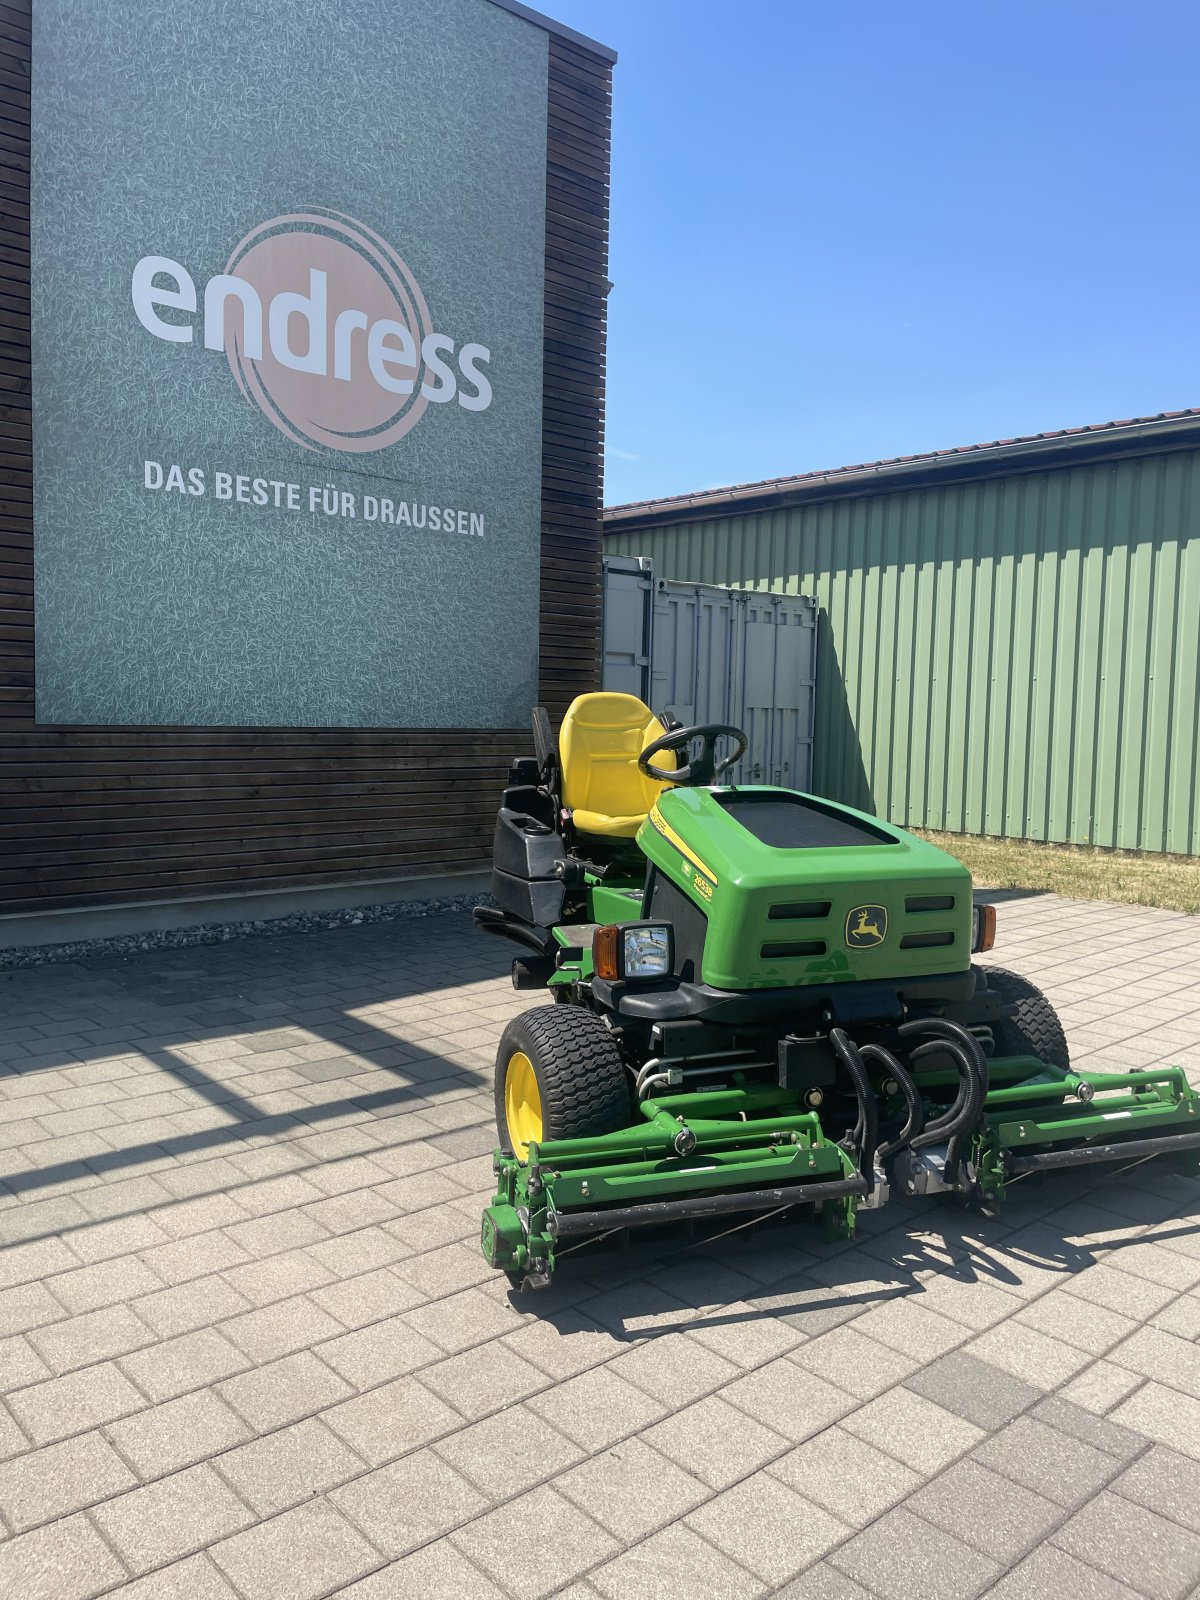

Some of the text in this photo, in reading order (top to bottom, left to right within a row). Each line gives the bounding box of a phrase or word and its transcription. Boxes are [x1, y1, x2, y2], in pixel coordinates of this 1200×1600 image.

[132, 256, 493, 412] endress
[144, 460, 485, 537] DAS BESTE FÜR DRAUSSEN
